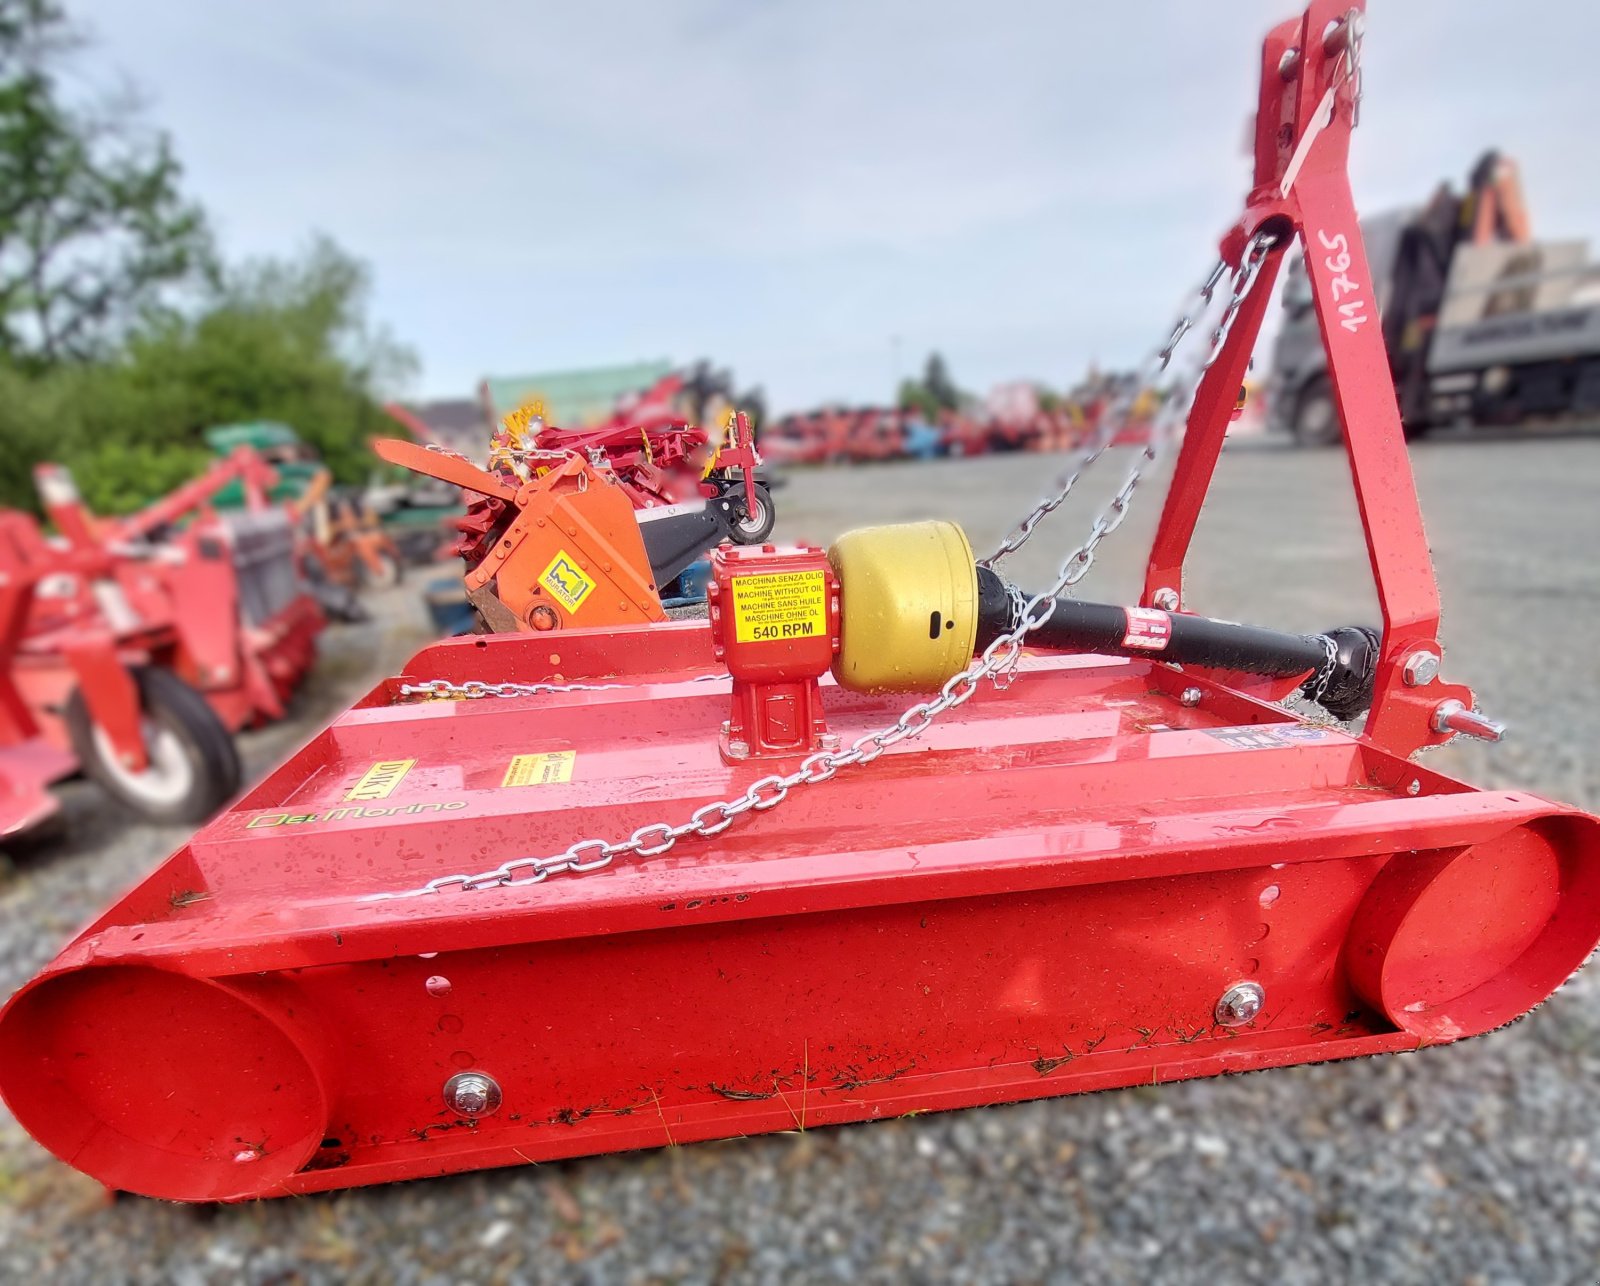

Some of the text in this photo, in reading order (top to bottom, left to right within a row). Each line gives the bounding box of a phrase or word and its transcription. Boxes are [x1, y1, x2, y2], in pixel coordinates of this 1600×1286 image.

[1318, 229, 1368, 332] 11765
[736, 576, 776, 586] MACCHINA
[778, 573, 804, 583] SENZA
[806, 572, 824, 580] OLIO
[545, 576, 576, 607] MURATORI
[737, 590, 776, 599] MACHINE
[775, 587, 809, 596] WITHOUT
[811, 584, 823, 592] OIL
[741, 602, 776, 611] MACHINE
[777, 599, 798, 608] SANS
[799, 597, 822, 605] HUILE
[745, 612, 784, 623] MASCHINE
[786, 610, 807, 618] OHNE
[753, 622, 813, 640] 540 RPM
[322, 800, 469, 821] Morino
